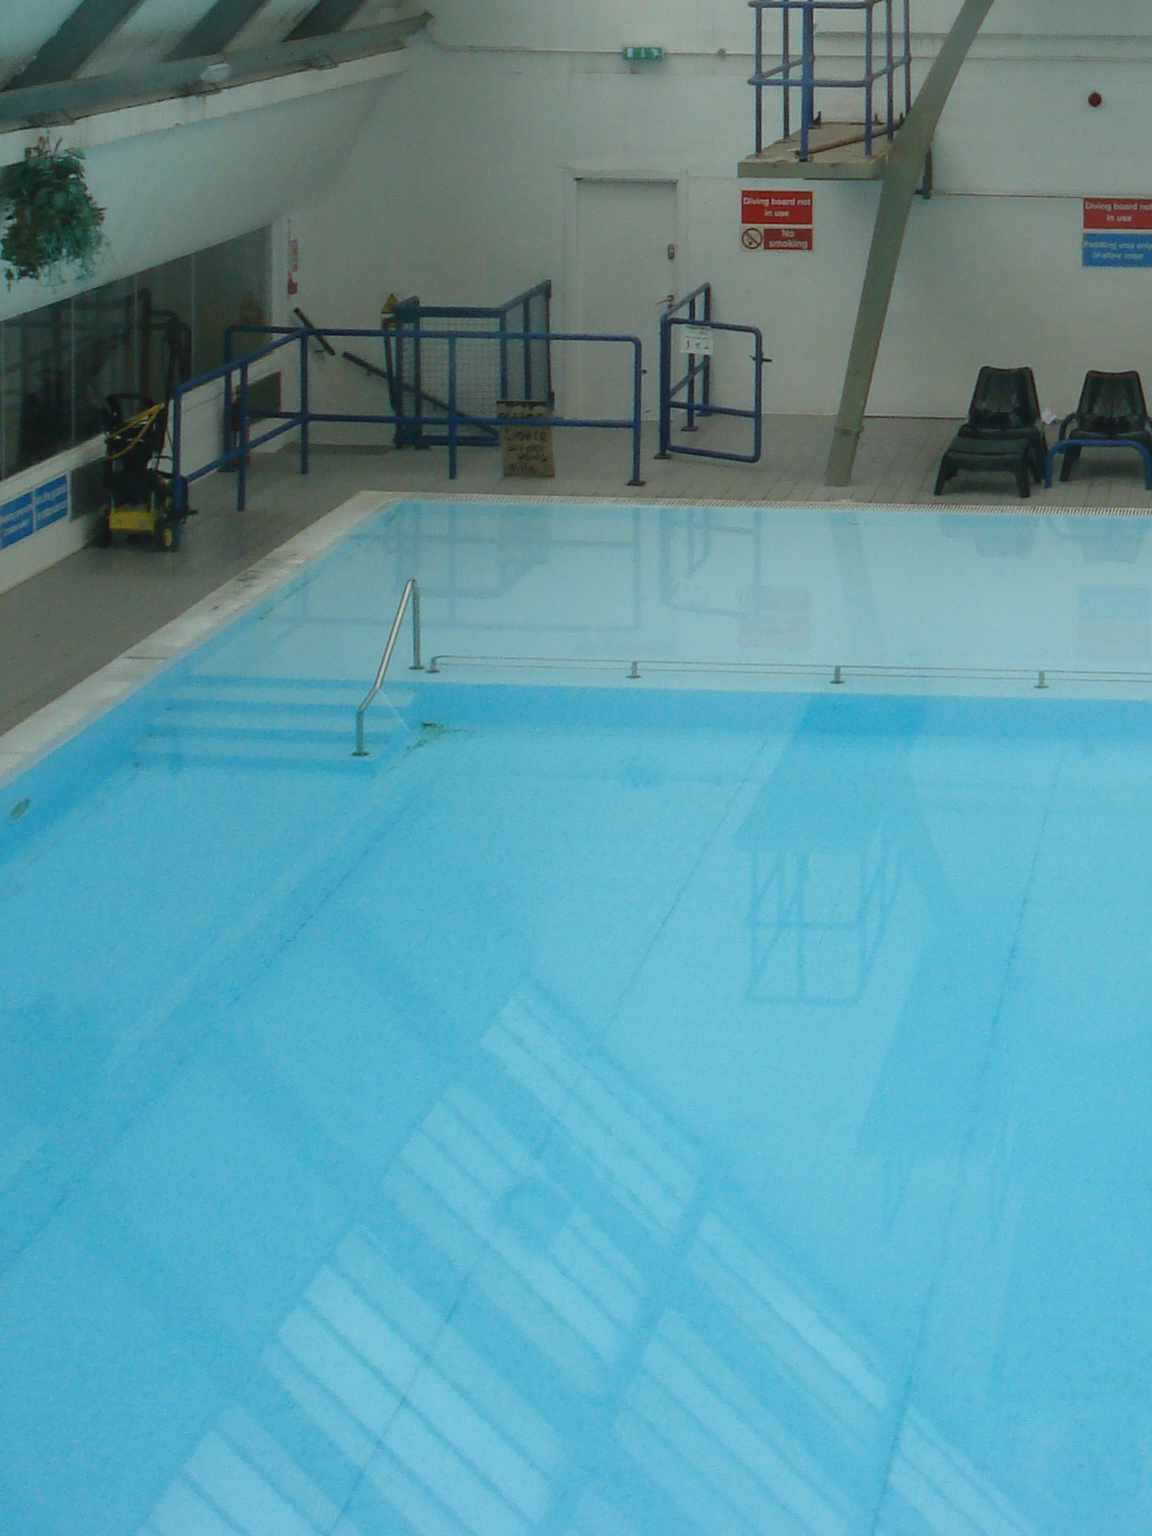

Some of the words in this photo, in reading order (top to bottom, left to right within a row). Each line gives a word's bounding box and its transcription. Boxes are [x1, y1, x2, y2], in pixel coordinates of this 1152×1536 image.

[743, 197, 769, 207] Diving
[771, 198, 795, 206] board
[797, 198, 811, 206] not
[1085, 202, 1112, 211] Diving
[1139, 203, 1152, 211] not
[781, 229, 795, 237] No
[768, 239, 808, 250] smoking
